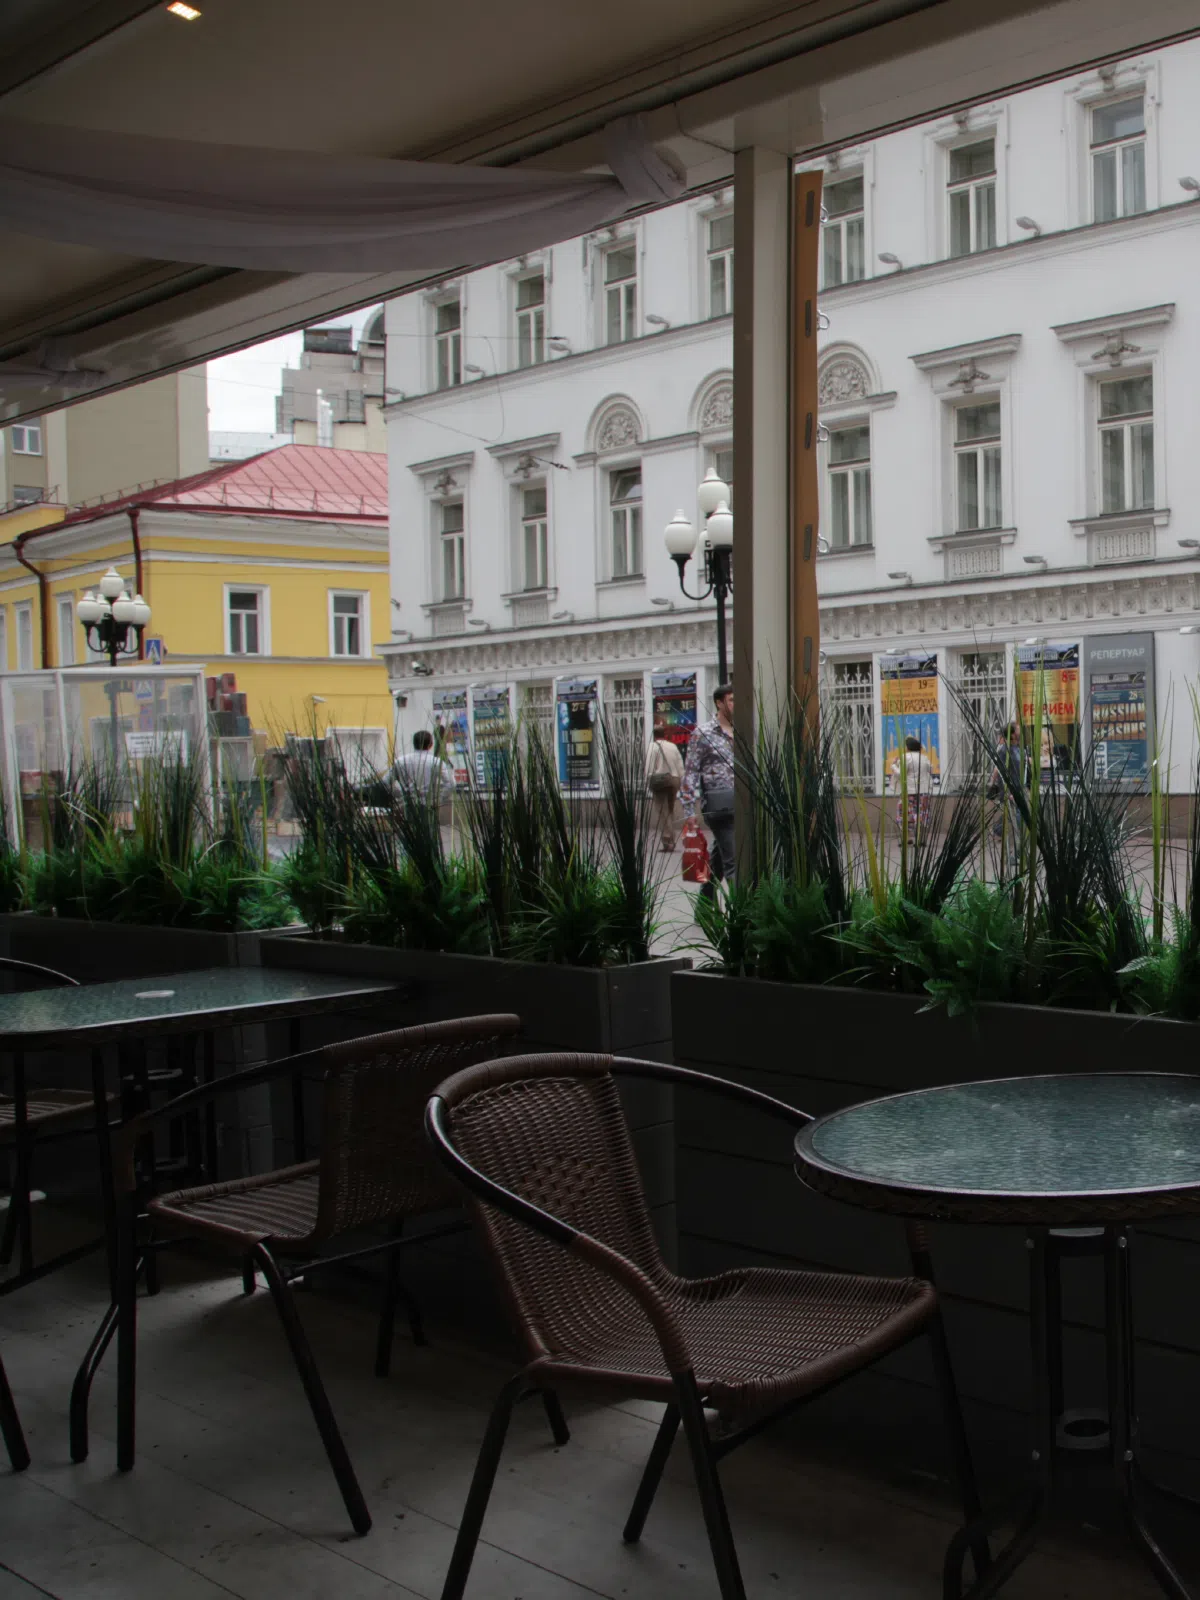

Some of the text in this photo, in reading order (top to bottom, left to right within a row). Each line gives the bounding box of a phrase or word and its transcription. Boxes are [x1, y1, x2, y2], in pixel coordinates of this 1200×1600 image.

[1090, 648, 1146, 660] РЕПЕРТУАР
[918, 679, 928, 690] 19
[1023, 702, 1075, 717] РЕВИЕМ
[1093, 703, 1146, 721] RUSSIAN
[1093, 722, 1147, 741] SEASONS
